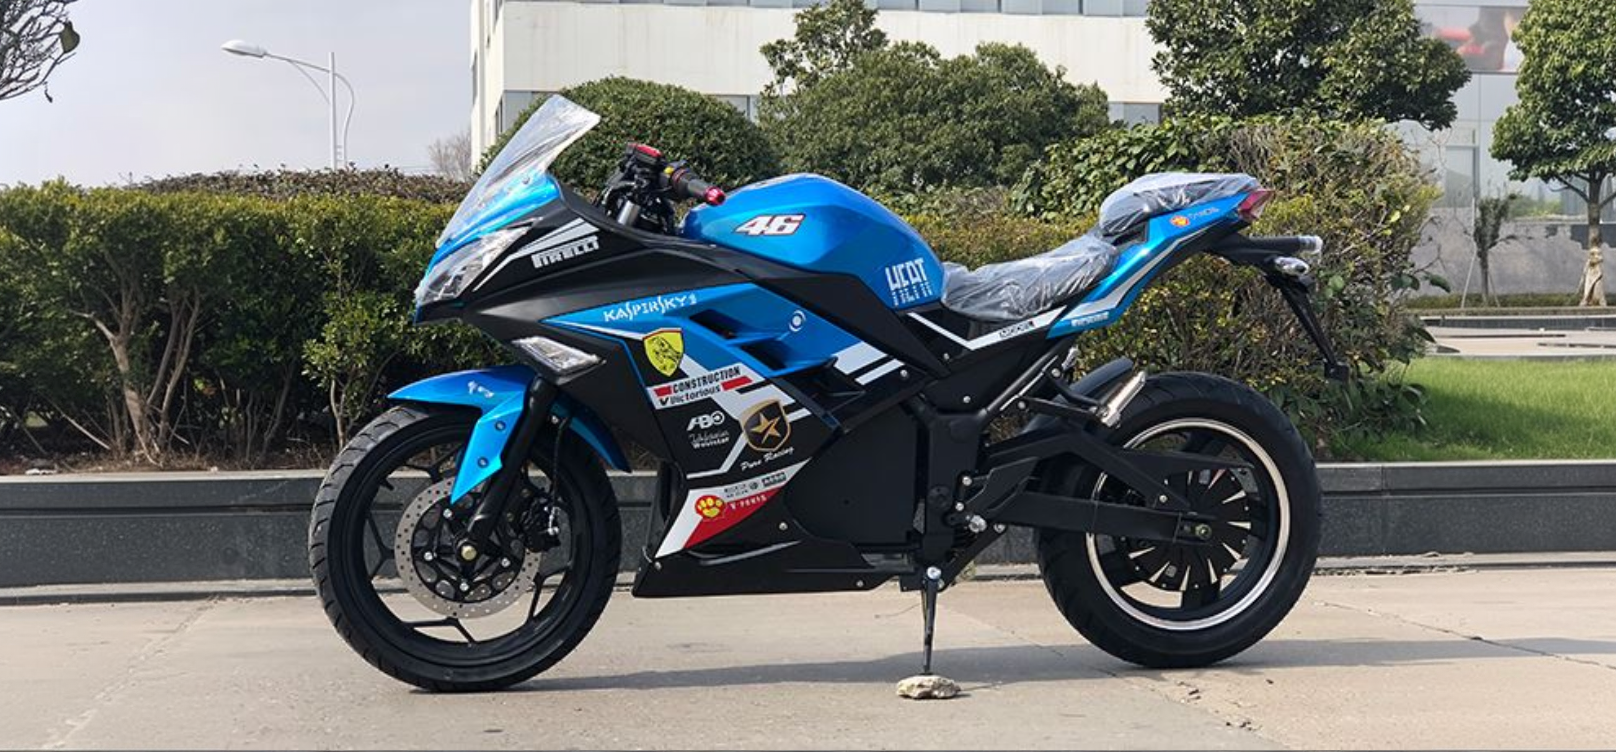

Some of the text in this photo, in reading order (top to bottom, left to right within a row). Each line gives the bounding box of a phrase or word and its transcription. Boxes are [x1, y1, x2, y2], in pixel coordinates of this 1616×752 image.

[733, 213, 806, 236] 46
[672, 366, 741, 394] CONSTRUCTION
[670, 385, 721, 405] Victorious
